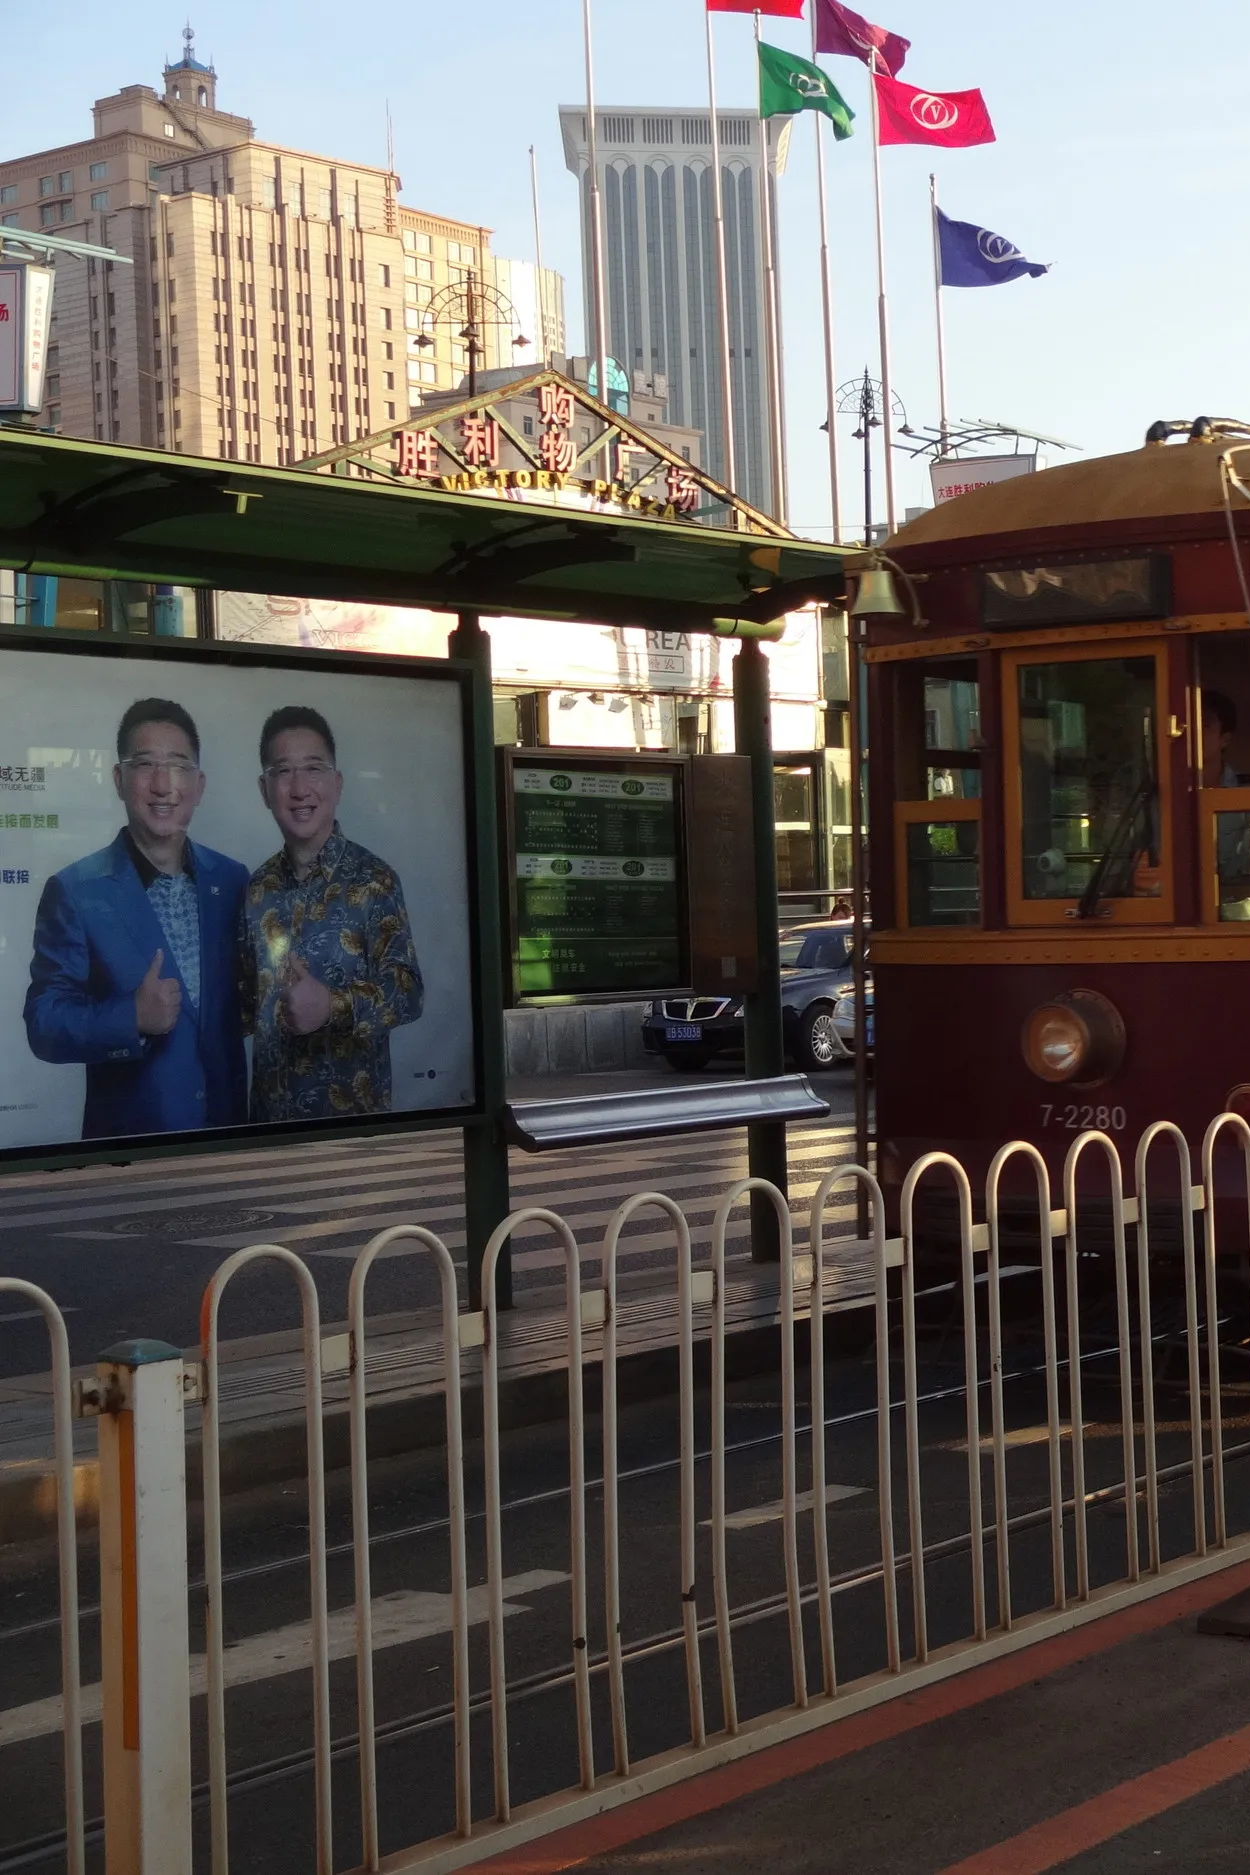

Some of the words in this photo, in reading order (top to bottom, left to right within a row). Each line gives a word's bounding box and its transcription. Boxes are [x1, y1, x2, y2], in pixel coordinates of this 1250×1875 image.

[440, 470, 569, 491] VICTORY
[594, 480, 676, 520] PLAZA
[0, 870, 29, 884] 联接
[1040, 1104, 1127, 1131] 7-2280
